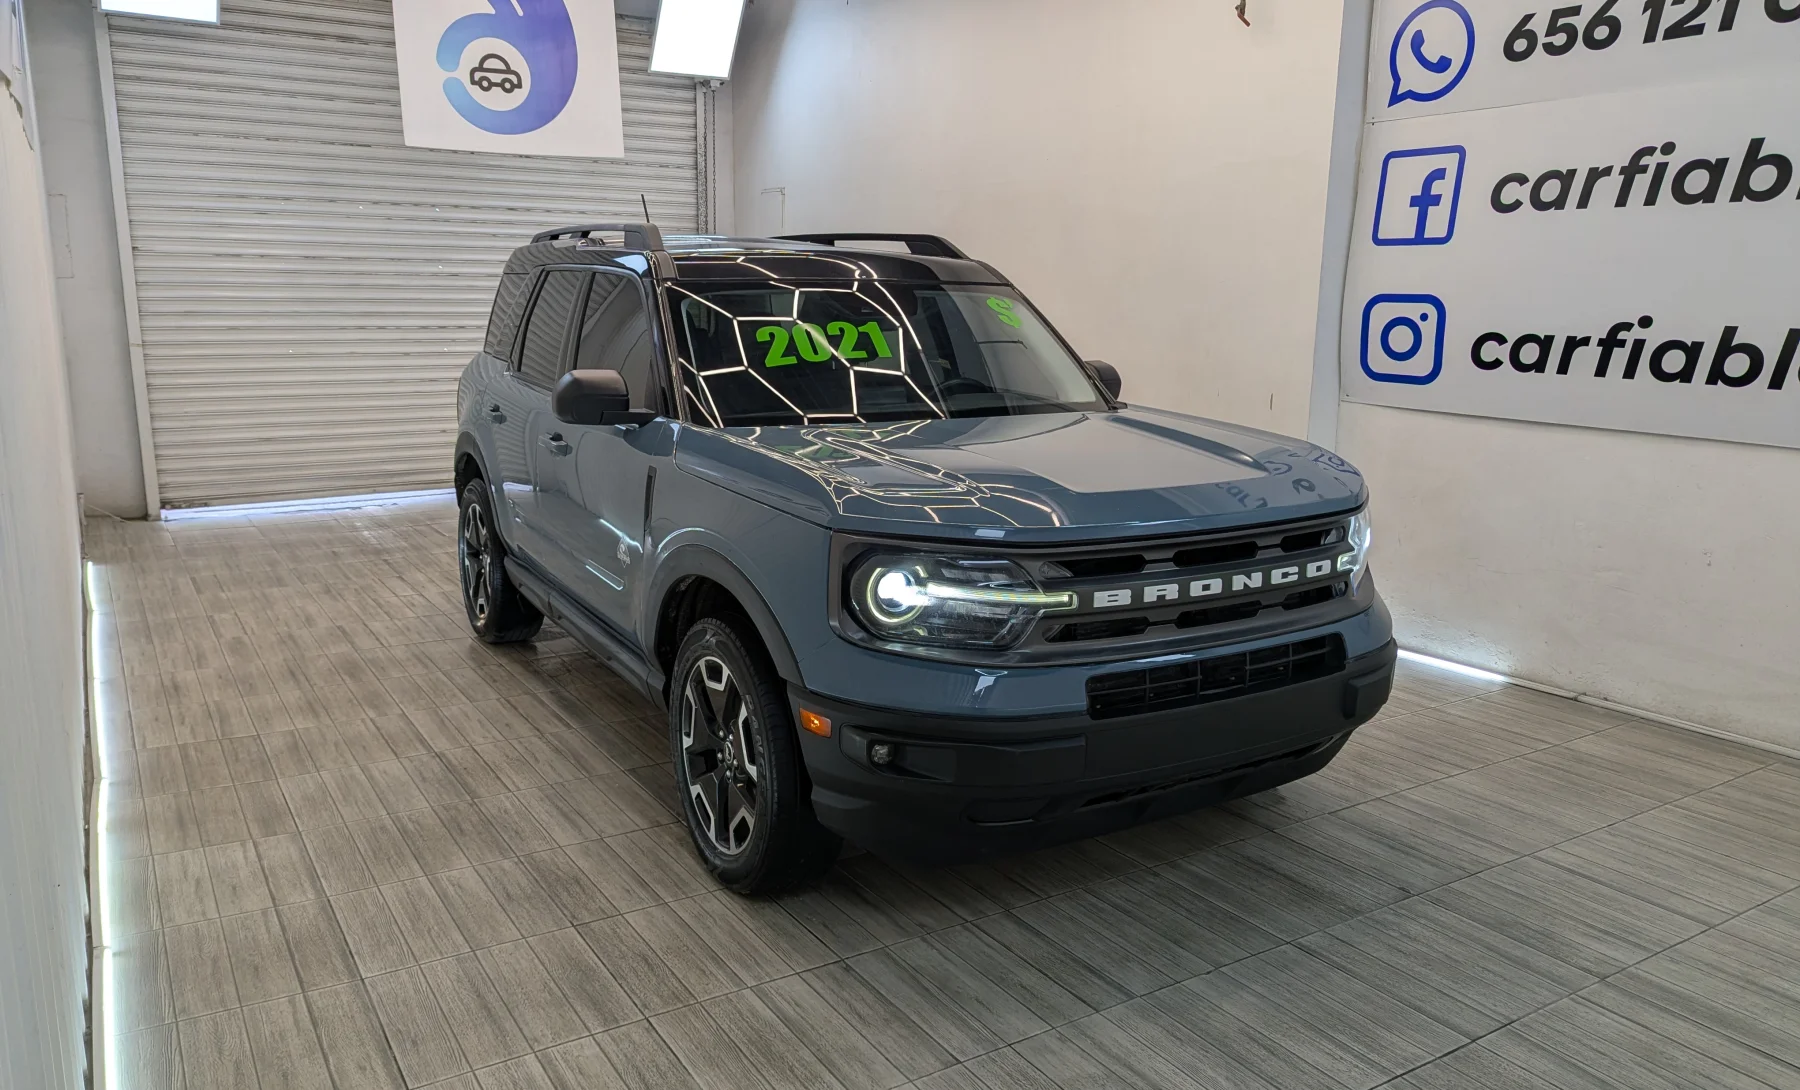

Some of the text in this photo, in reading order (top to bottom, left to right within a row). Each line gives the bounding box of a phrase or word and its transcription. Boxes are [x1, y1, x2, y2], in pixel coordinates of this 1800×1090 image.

[1503, 0, 1622, 62] 656
[1641, 0, 1740, 44] 121
[1490, 137, 1800, 214] carfiab
[756, 321, 893, 367] 2021
[1470, 315, 1800, 390] carfiabl
[1093, 559, 1332, 608] BRONCO
